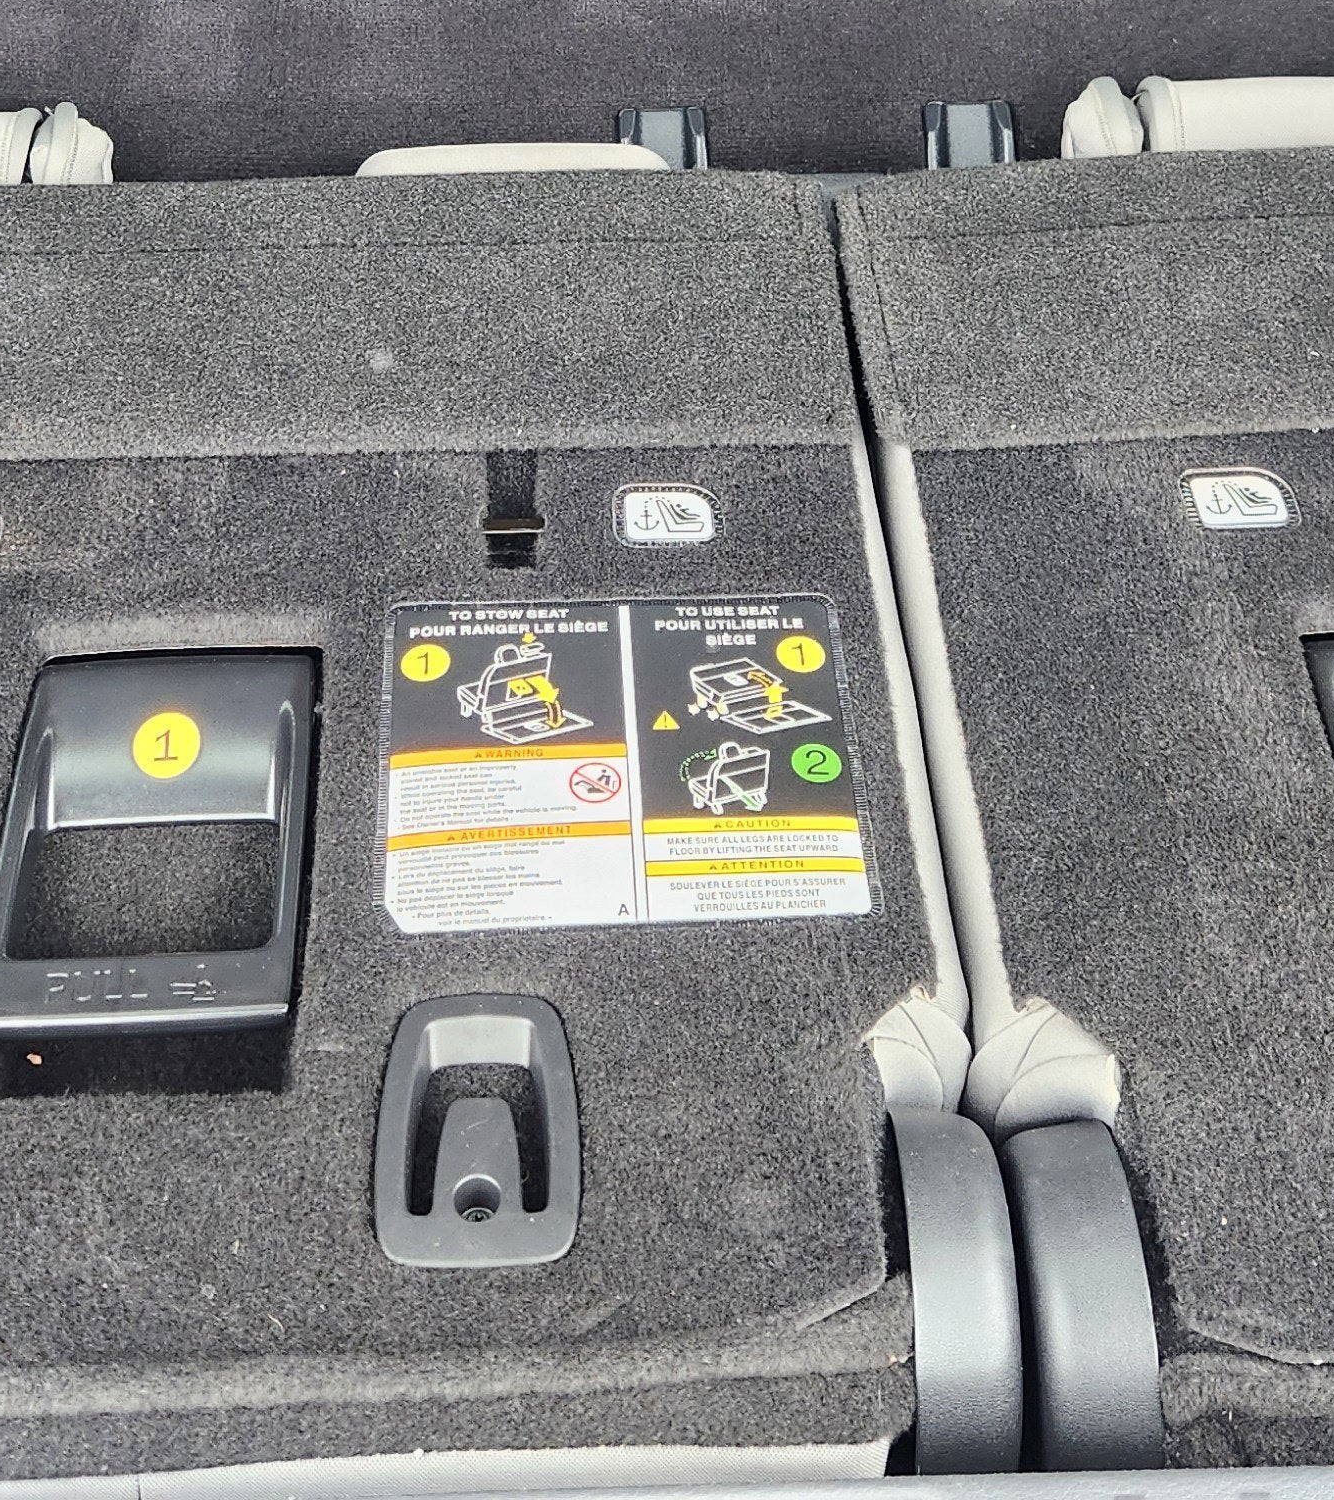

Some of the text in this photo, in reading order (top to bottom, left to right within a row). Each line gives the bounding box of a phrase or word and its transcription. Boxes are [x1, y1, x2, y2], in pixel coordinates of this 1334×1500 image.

[448, 608, 569, 621] TO STOW SEAT
[675, 605, 780, 617] TO USE SEAT
[409, 619, 609, 638] POUR RANGER LE SIÈGE
[654, 618, 804, 631] POUR UTILISER LE
[705, 632, 757, 645] SIÈGE
[791, 642, 805, 666] 1
[417, 651, 429, 675] 1
[153, 729, 179, 762] 1
[485, 748, 544, 759] WARNING
[806, 750, 829, 775] 2
[725, 820, 791, 828] CAUTION
[460, 825, 572, 841] AVERTISSEMENT
[695, 836, 719, 844] SURE
[741, 835, 765, 843] LEGS
[717, 846, 751, 854] LIFTING
[773, 844, 797, 852] SEAT
[799, 844, 839, 852] UPWARD
[721, 860, 804, 870] ATTENTION
[670, 881, 719, 890] SOULEVER
[722, 880, 733, 888] LE
[765, 879, 791, 887] POUR
[697, 889, 820, 900] QUE TOUS LES PIEDS SONT
[618, 903, 630, 917] A
[761, 901, 774, 909] AU
[776, 900, 826, 909] PLANCHER
